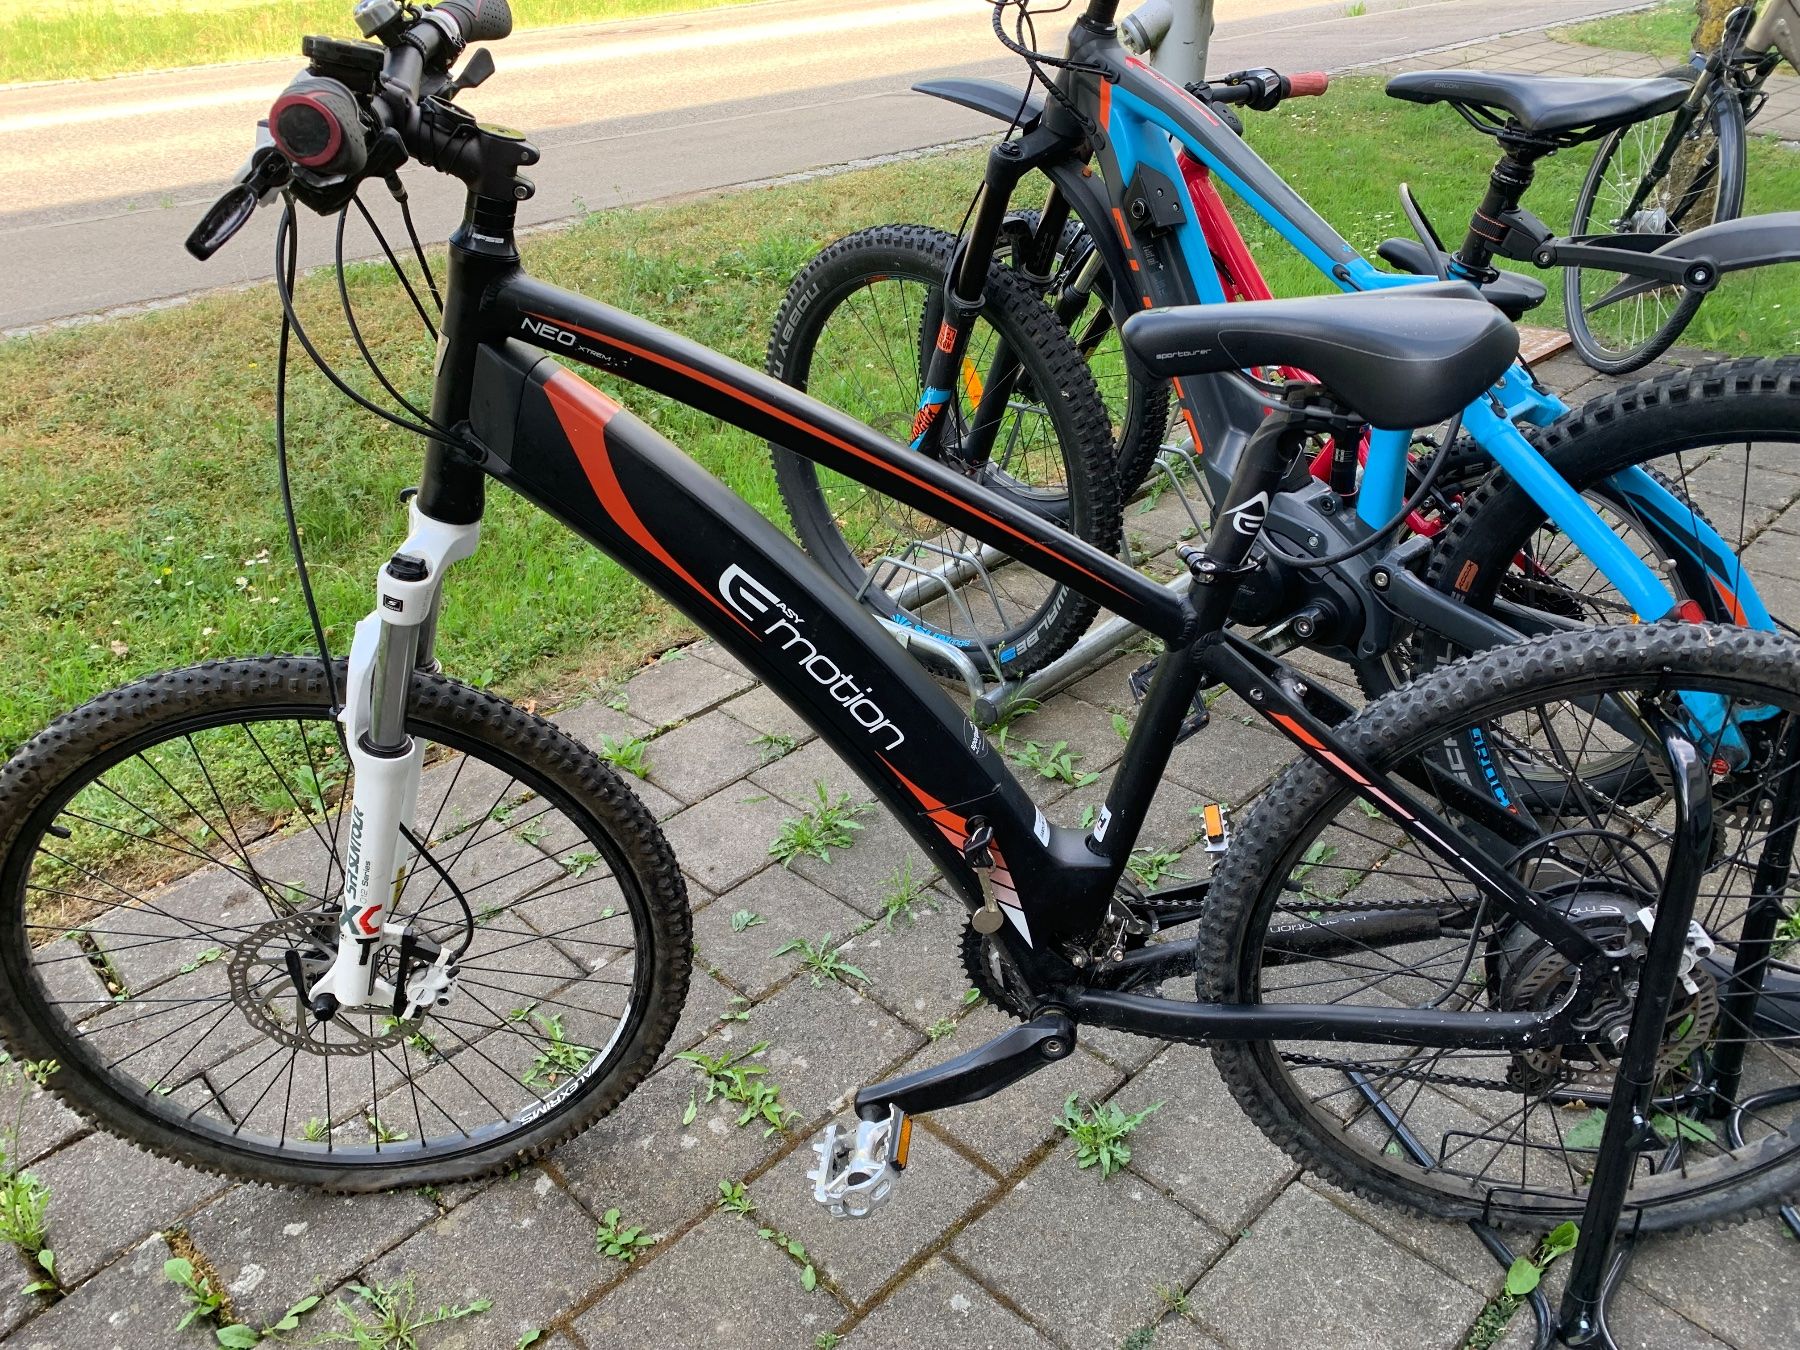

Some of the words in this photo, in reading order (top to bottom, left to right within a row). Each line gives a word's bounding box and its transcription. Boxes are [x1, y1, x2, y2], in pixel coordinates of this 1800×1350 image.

[521, 317, 576, 346] NEO
[778, 282, 821, 358] NOBBY
[1156, 349, 1212, 361] sportourer
[1015, 583, 1070, 656] WALBE
[361, 860, 371, 887] Series
[520, 1066, 595, 1126] ALEXRIMS
